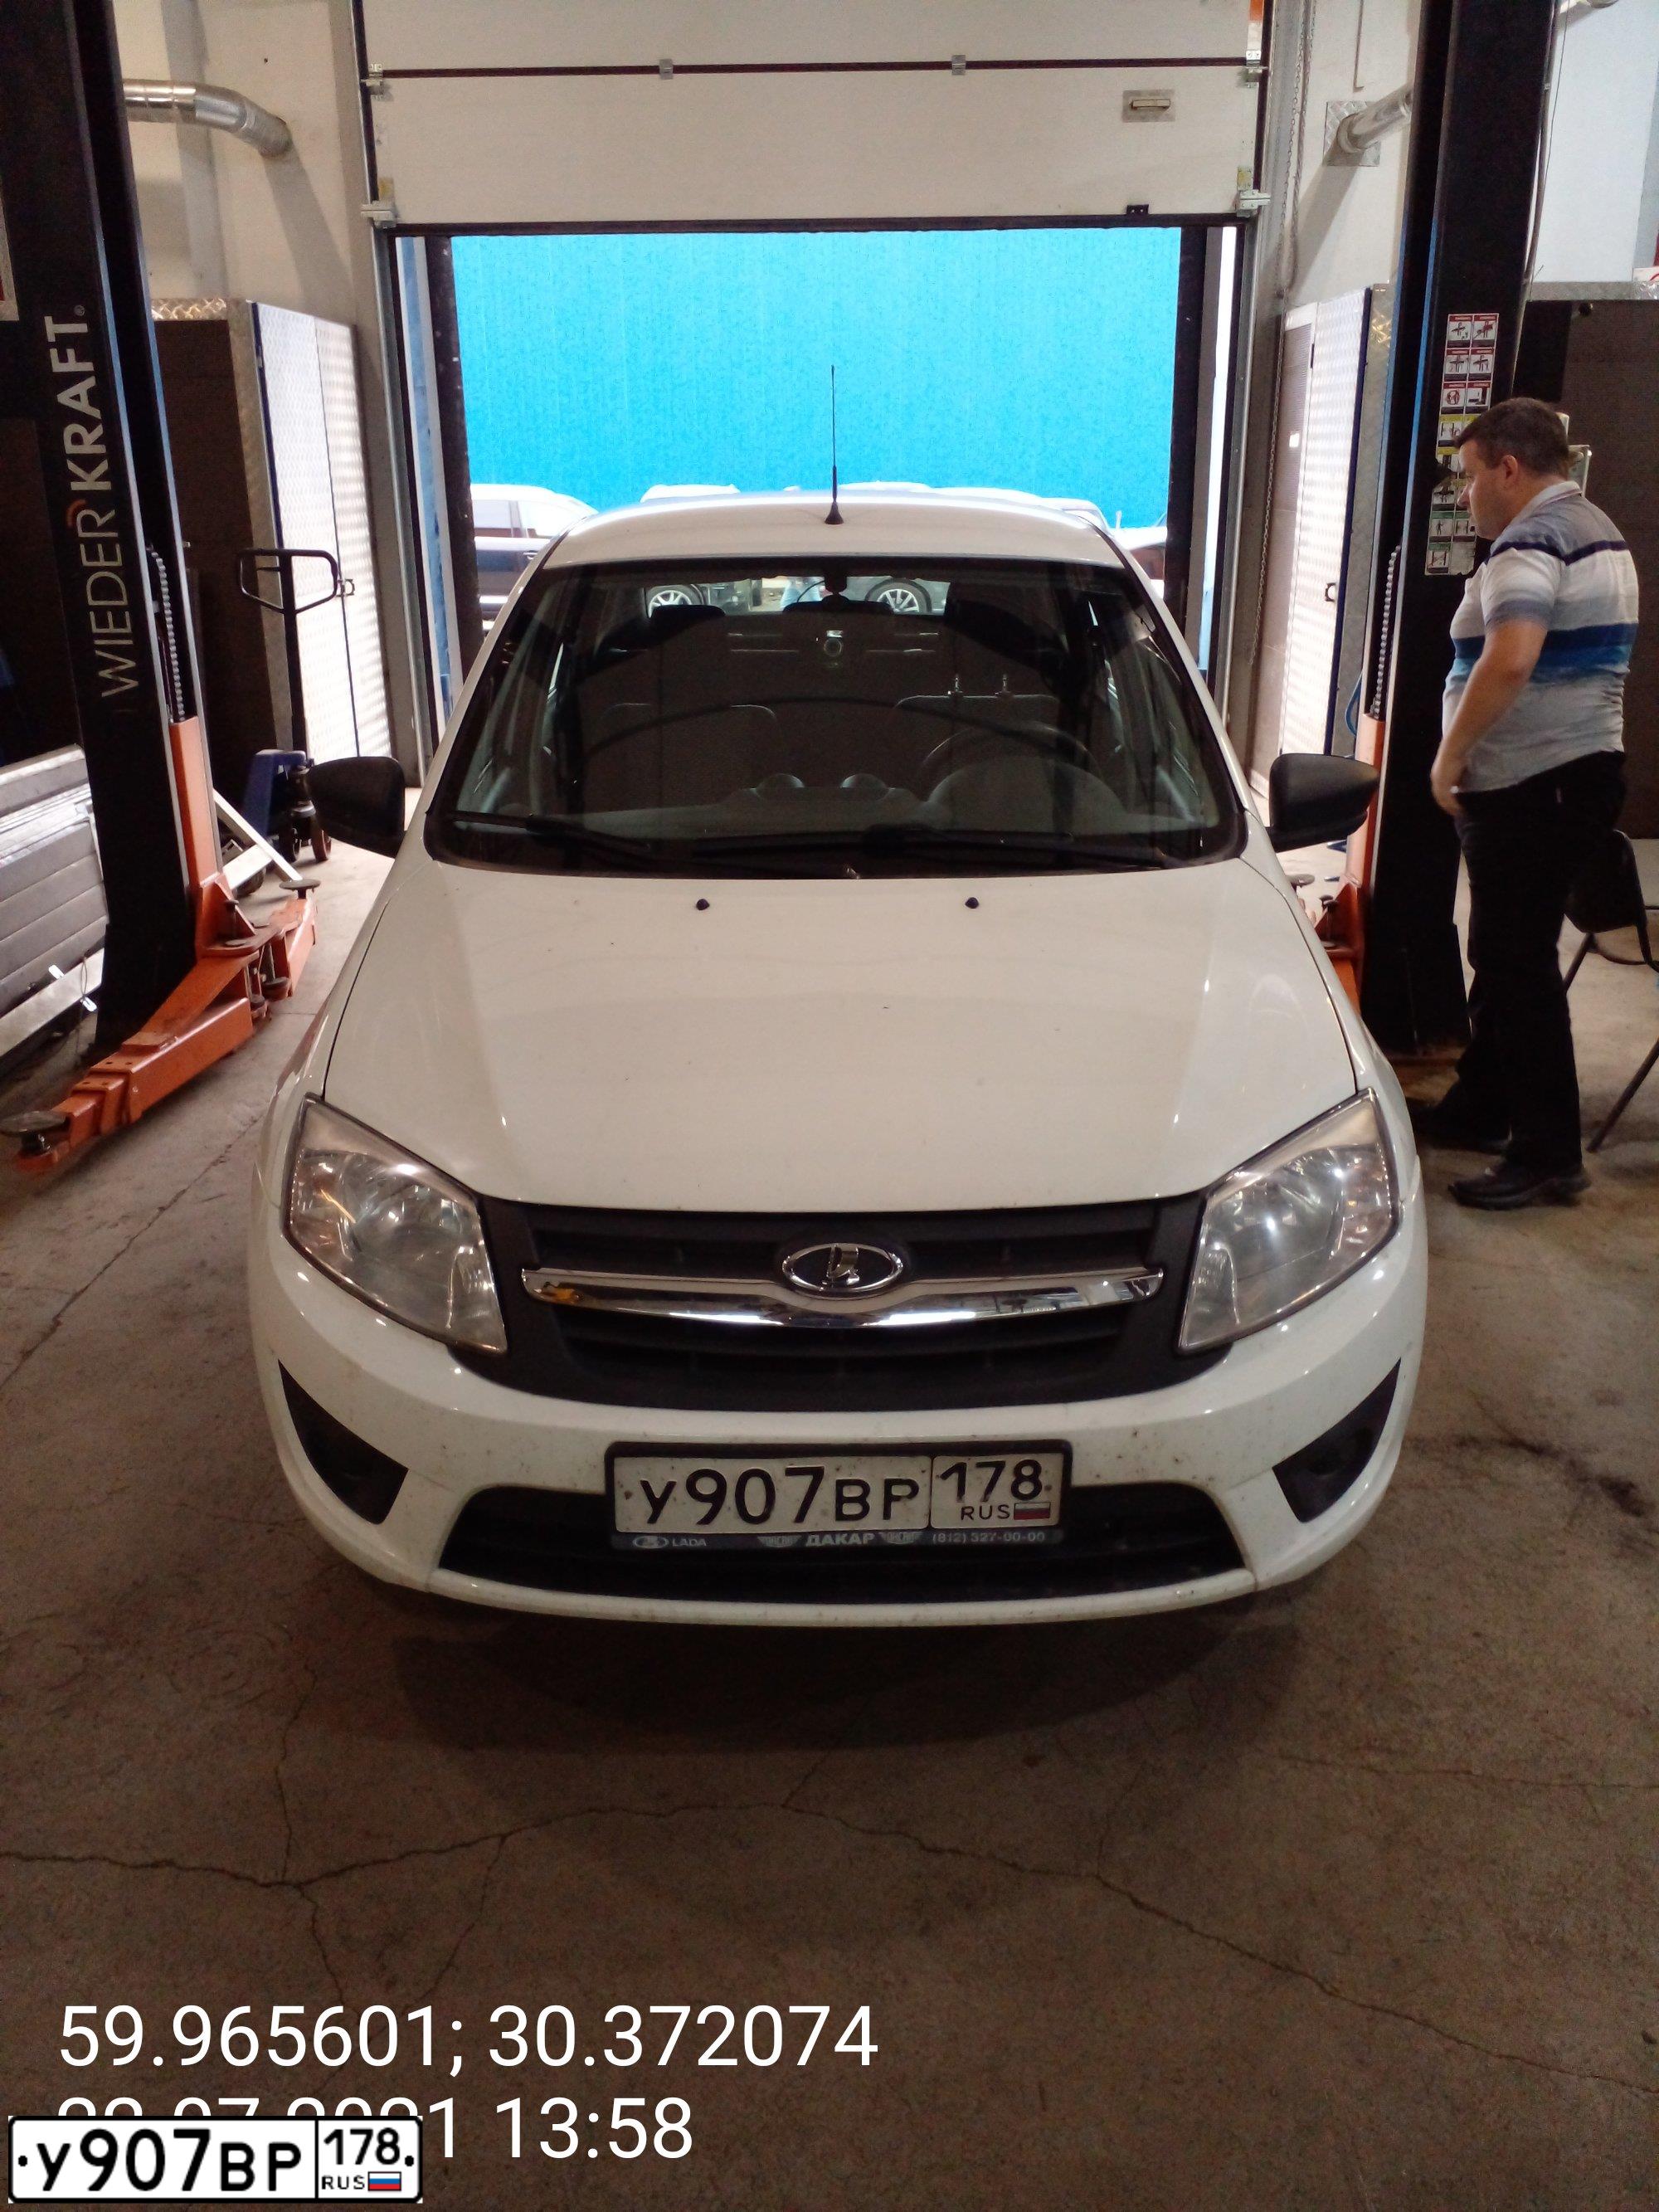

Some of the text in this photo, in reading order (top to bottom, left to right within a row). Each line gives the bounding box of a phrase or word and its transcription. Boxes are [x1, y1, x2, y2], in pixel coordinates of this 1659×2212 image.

[939, 1459, 1044, 1503] 178
[639, 1466, 921, 1527] У907ВР
[961, 1504, 1011, 1522] RUS
[672, 1538, 707, 1547] LADA
[805, 1532, 876, 1547] ДАКАР
[932, 1532, 967, 1544] (812)
